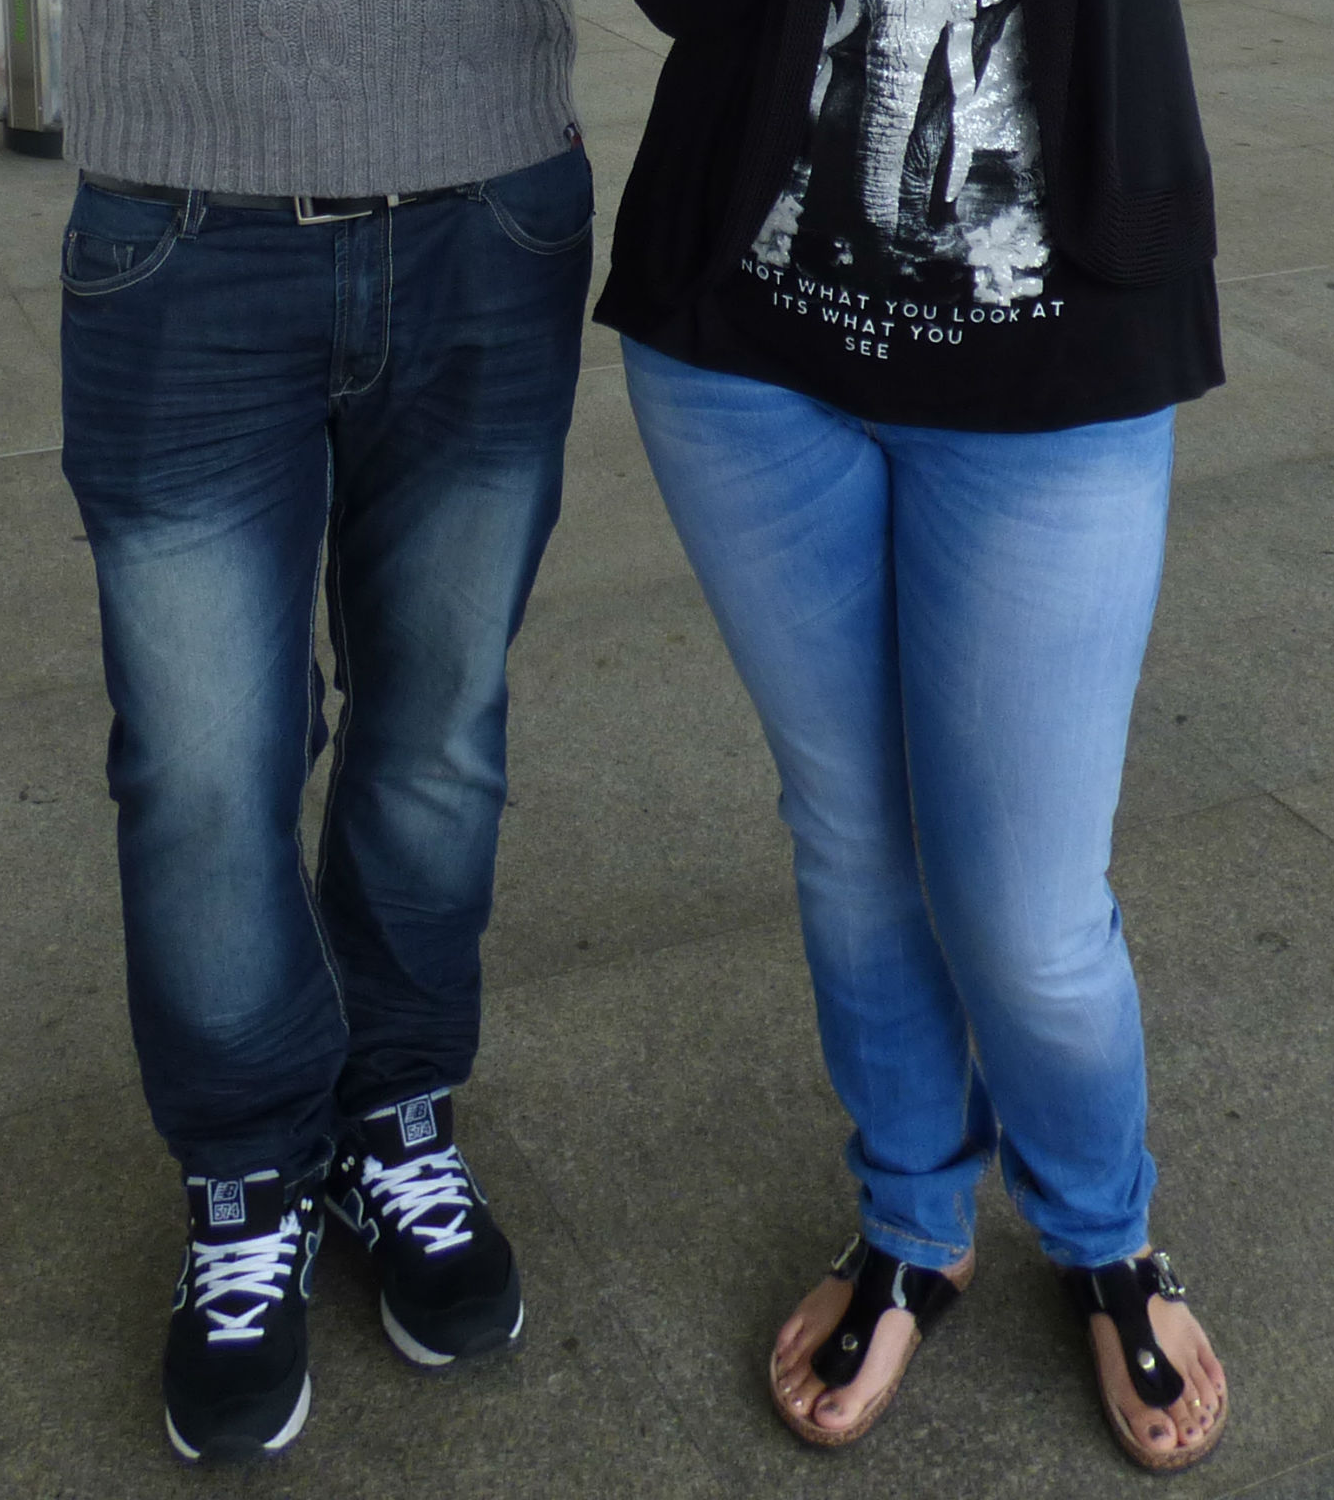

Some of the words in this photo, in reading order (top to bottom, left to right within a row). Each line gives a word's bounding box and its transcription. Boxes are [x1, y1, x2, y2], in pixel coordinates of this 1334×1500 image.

[741, 258, 785, 286] NOT
[797, 277, 870, 311] WHAT
[885, 300, 937, 321] YOU
[952, 306, 1021, 324] LOOK
[1031, 300, 1065, 319] AT
[773, 291, 808, 315] ITS
[822, 307, 895, 337] WHAT
[910, 324, 963, 345] YOU
[845, 336, 889, 360] SEE
[214, 1202, 240, 1221] 574
